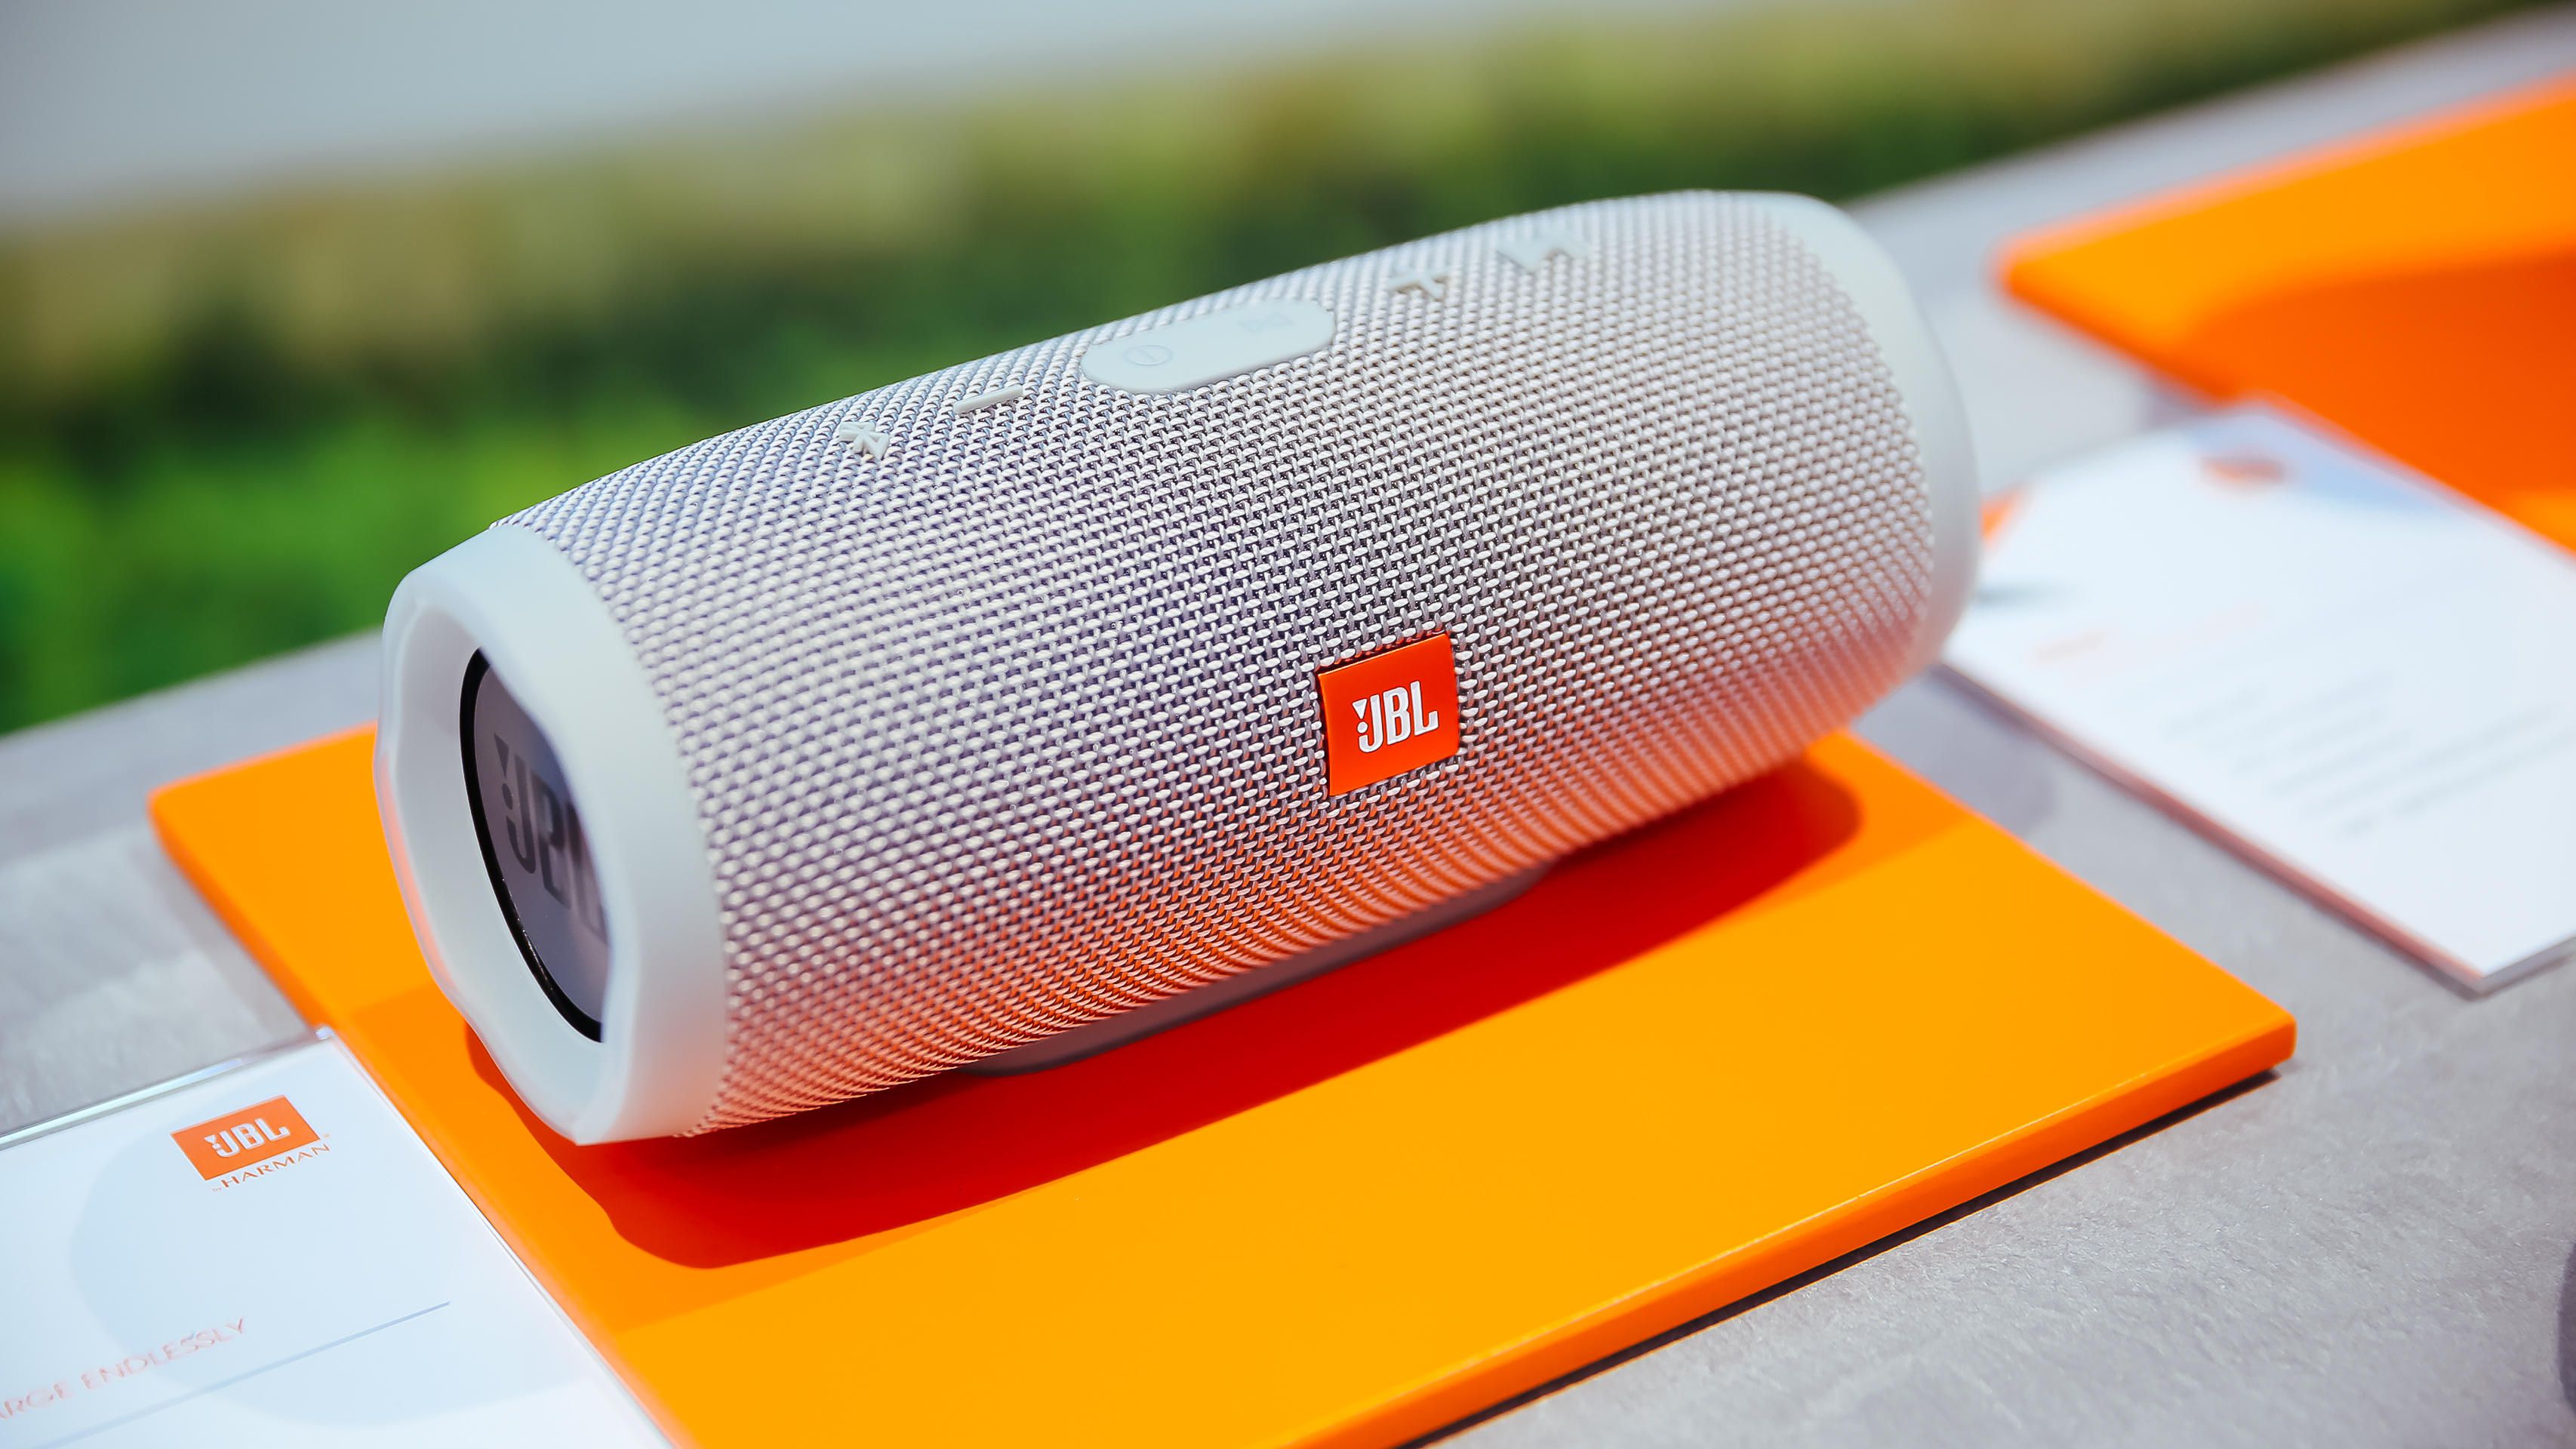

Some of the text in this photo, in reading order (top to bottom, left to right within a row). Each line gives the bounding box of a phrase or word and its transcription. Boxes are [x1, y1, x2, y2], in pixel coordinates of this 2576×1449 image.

[1352, 680, 1439, 753] JBL
[203, 1117, 291, 1158] JBL
[220, 1143, 331, 1188] HARMAN
[80, 1316, 244, 1389] ENDLESSLY
